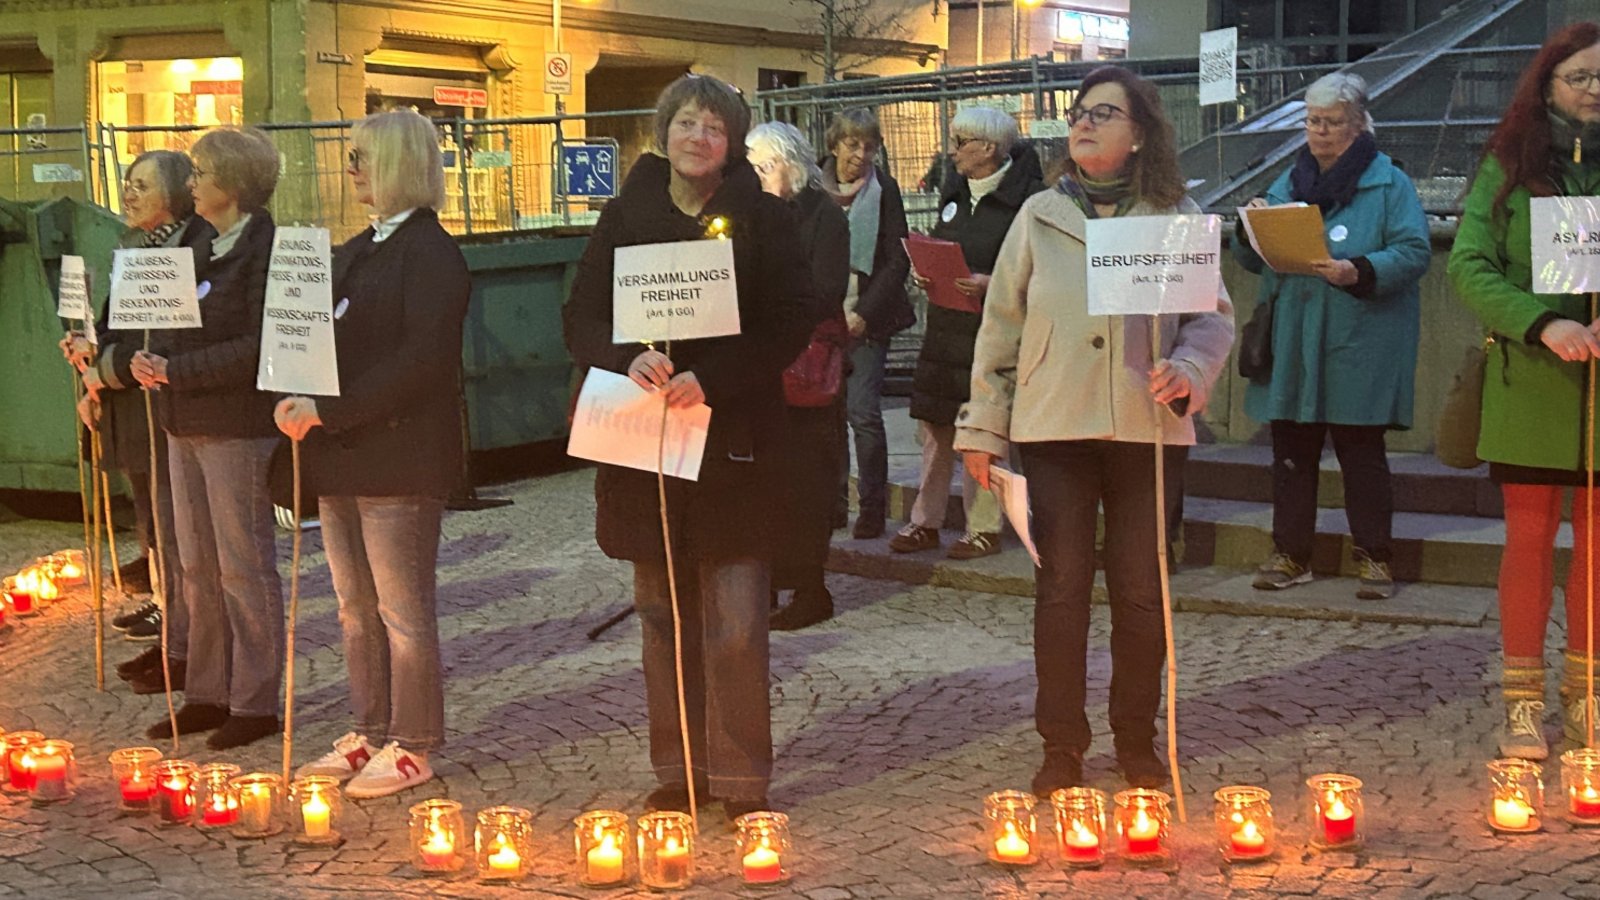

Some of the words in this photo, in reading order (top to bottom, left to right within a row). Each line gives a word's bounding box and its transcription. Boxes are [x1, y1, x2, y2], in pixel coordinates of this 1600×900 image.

[1091, 252, 1216, 267] BERUFSFREIHEIT
[616, 268, 730, 287] VERSAMMLUNGS
[139, 284, 159, 294] UND
[284, 287, 301, 298] UND
[641, 287, 702, 302] FREIHEIT
[112, 312, 152, 322] FREIHEIT
[646, 309, 665, 319] (Art.
[675, 306, 694, 318] GG)
[276, 324, 310, 336] FREIHEIT
